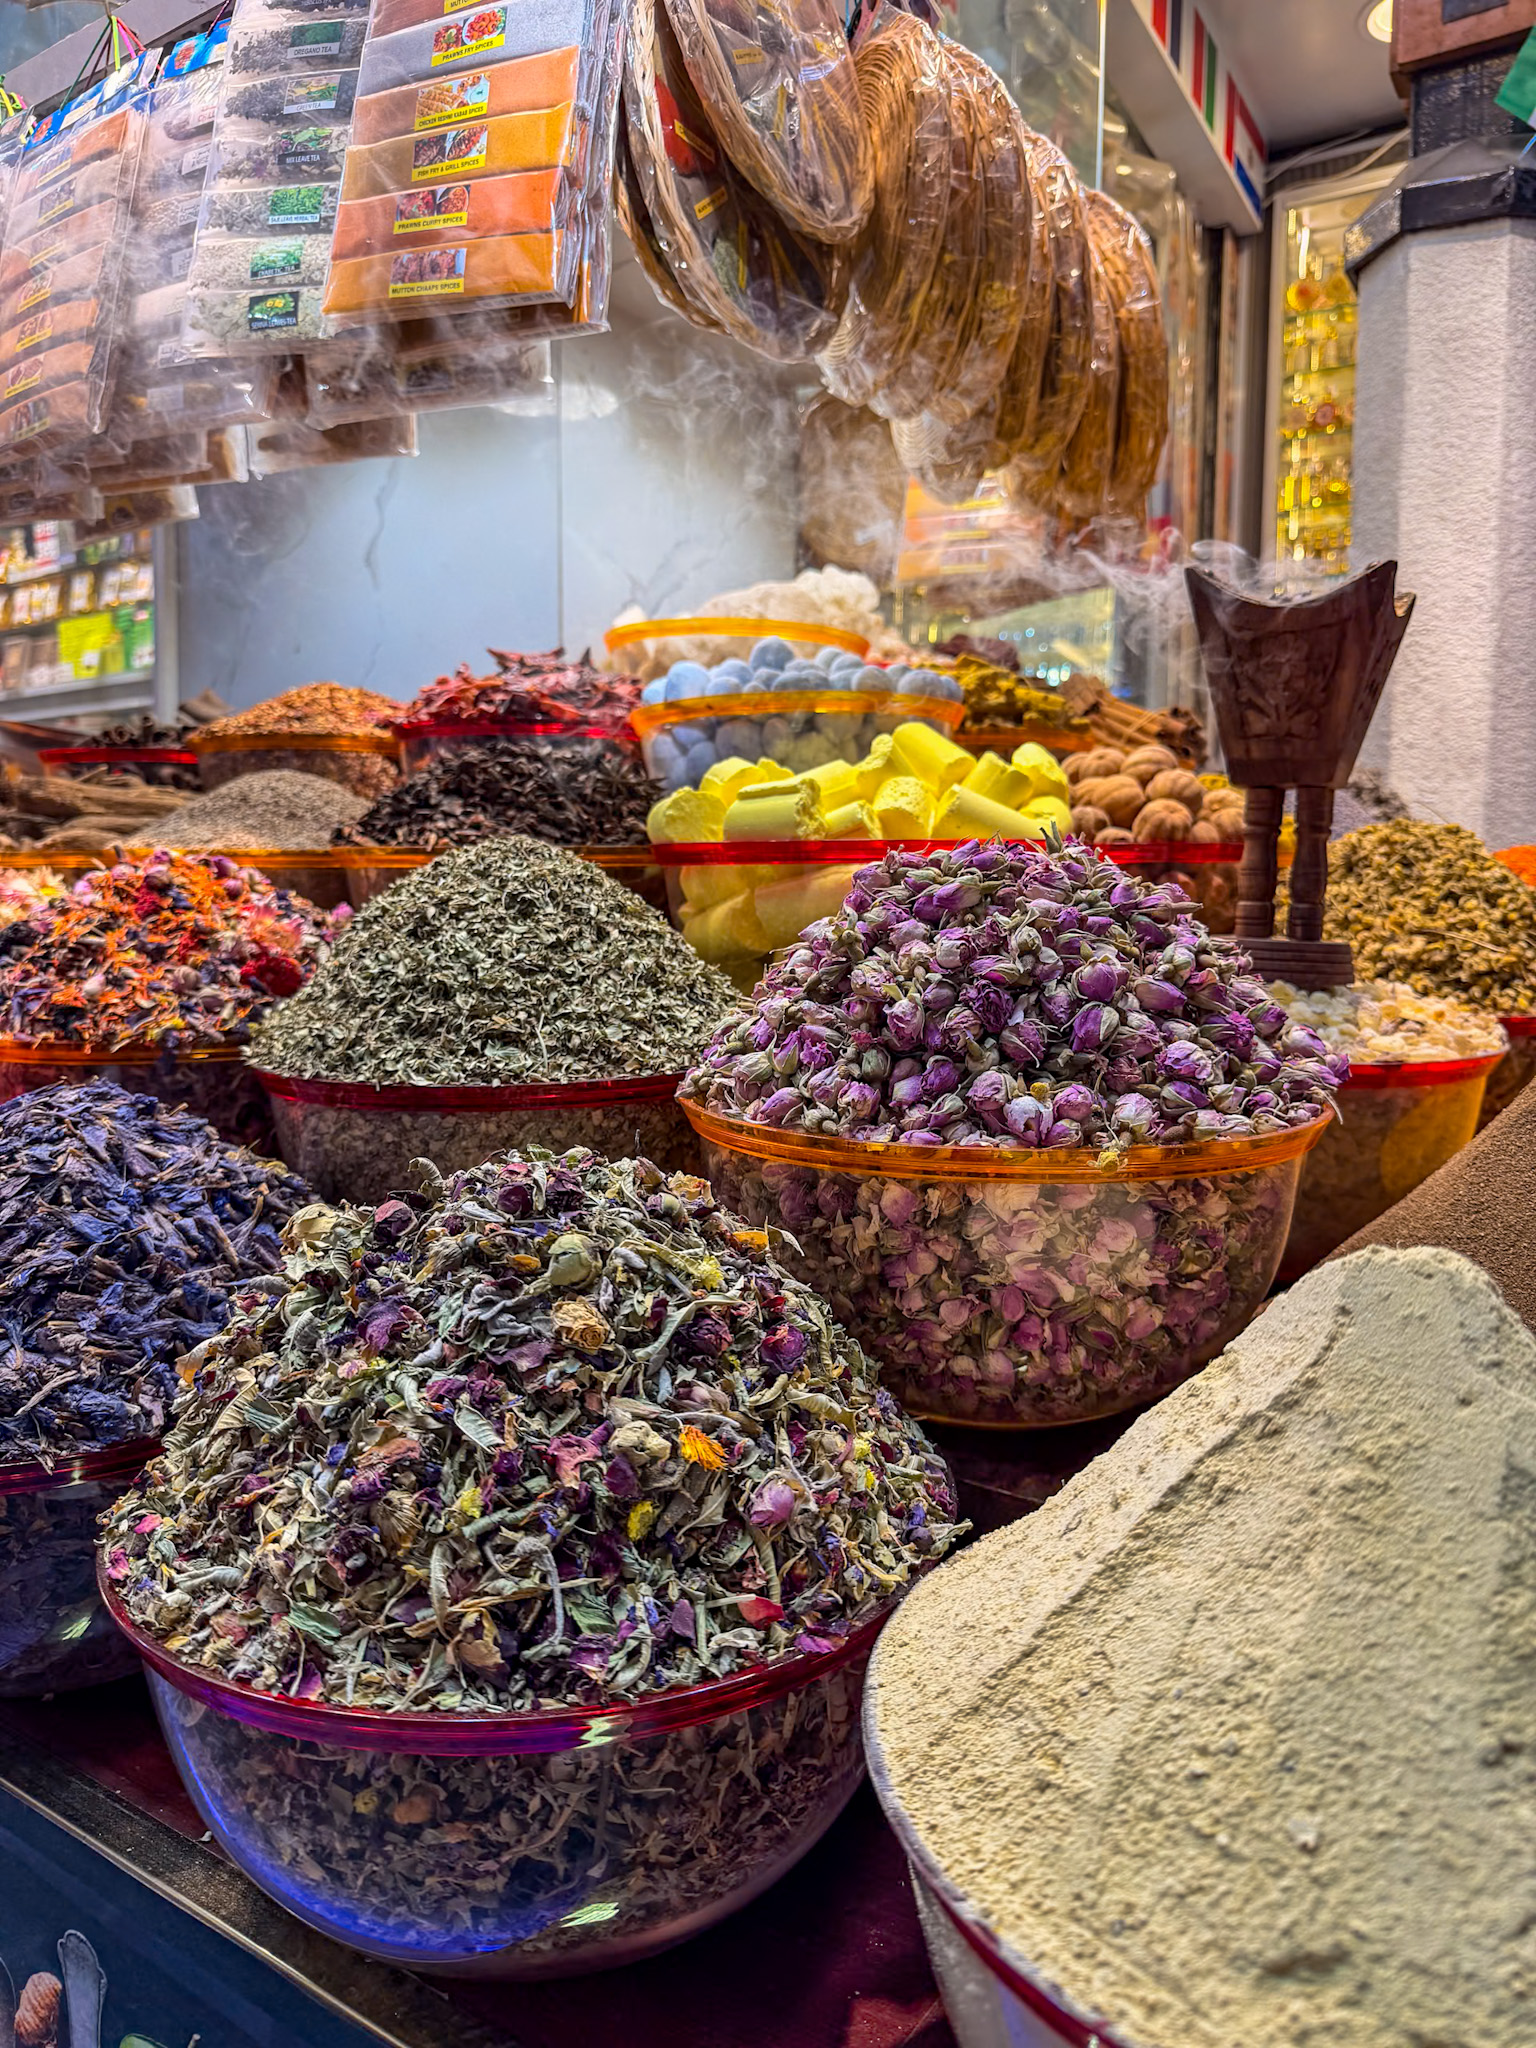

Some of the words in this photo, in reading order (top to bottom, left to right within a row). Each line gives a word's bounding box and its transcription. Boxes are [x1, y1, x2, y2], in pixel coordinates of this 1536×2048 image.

[294, 47, 320, 56] OREGANO
[442, 49, 463, 61] PRAWNS
[464, 46, 474, 55] FRY
[475, 40, 494, 51] SPICES
[311, 154, 321, 162] TEA
[417, 169, 429, 177] FISH
[430, 167, 439, 175] FRY
[445, 163, 460, 171] GRILL
[461, 159, 479, 168] SPICES
[398, 221, 421, 230] PRAWNS
[442, 215, 463, 224] SPICES
[391, 285, 415, 294] MUTTON
[440, 282, 461, 290] SPICES
